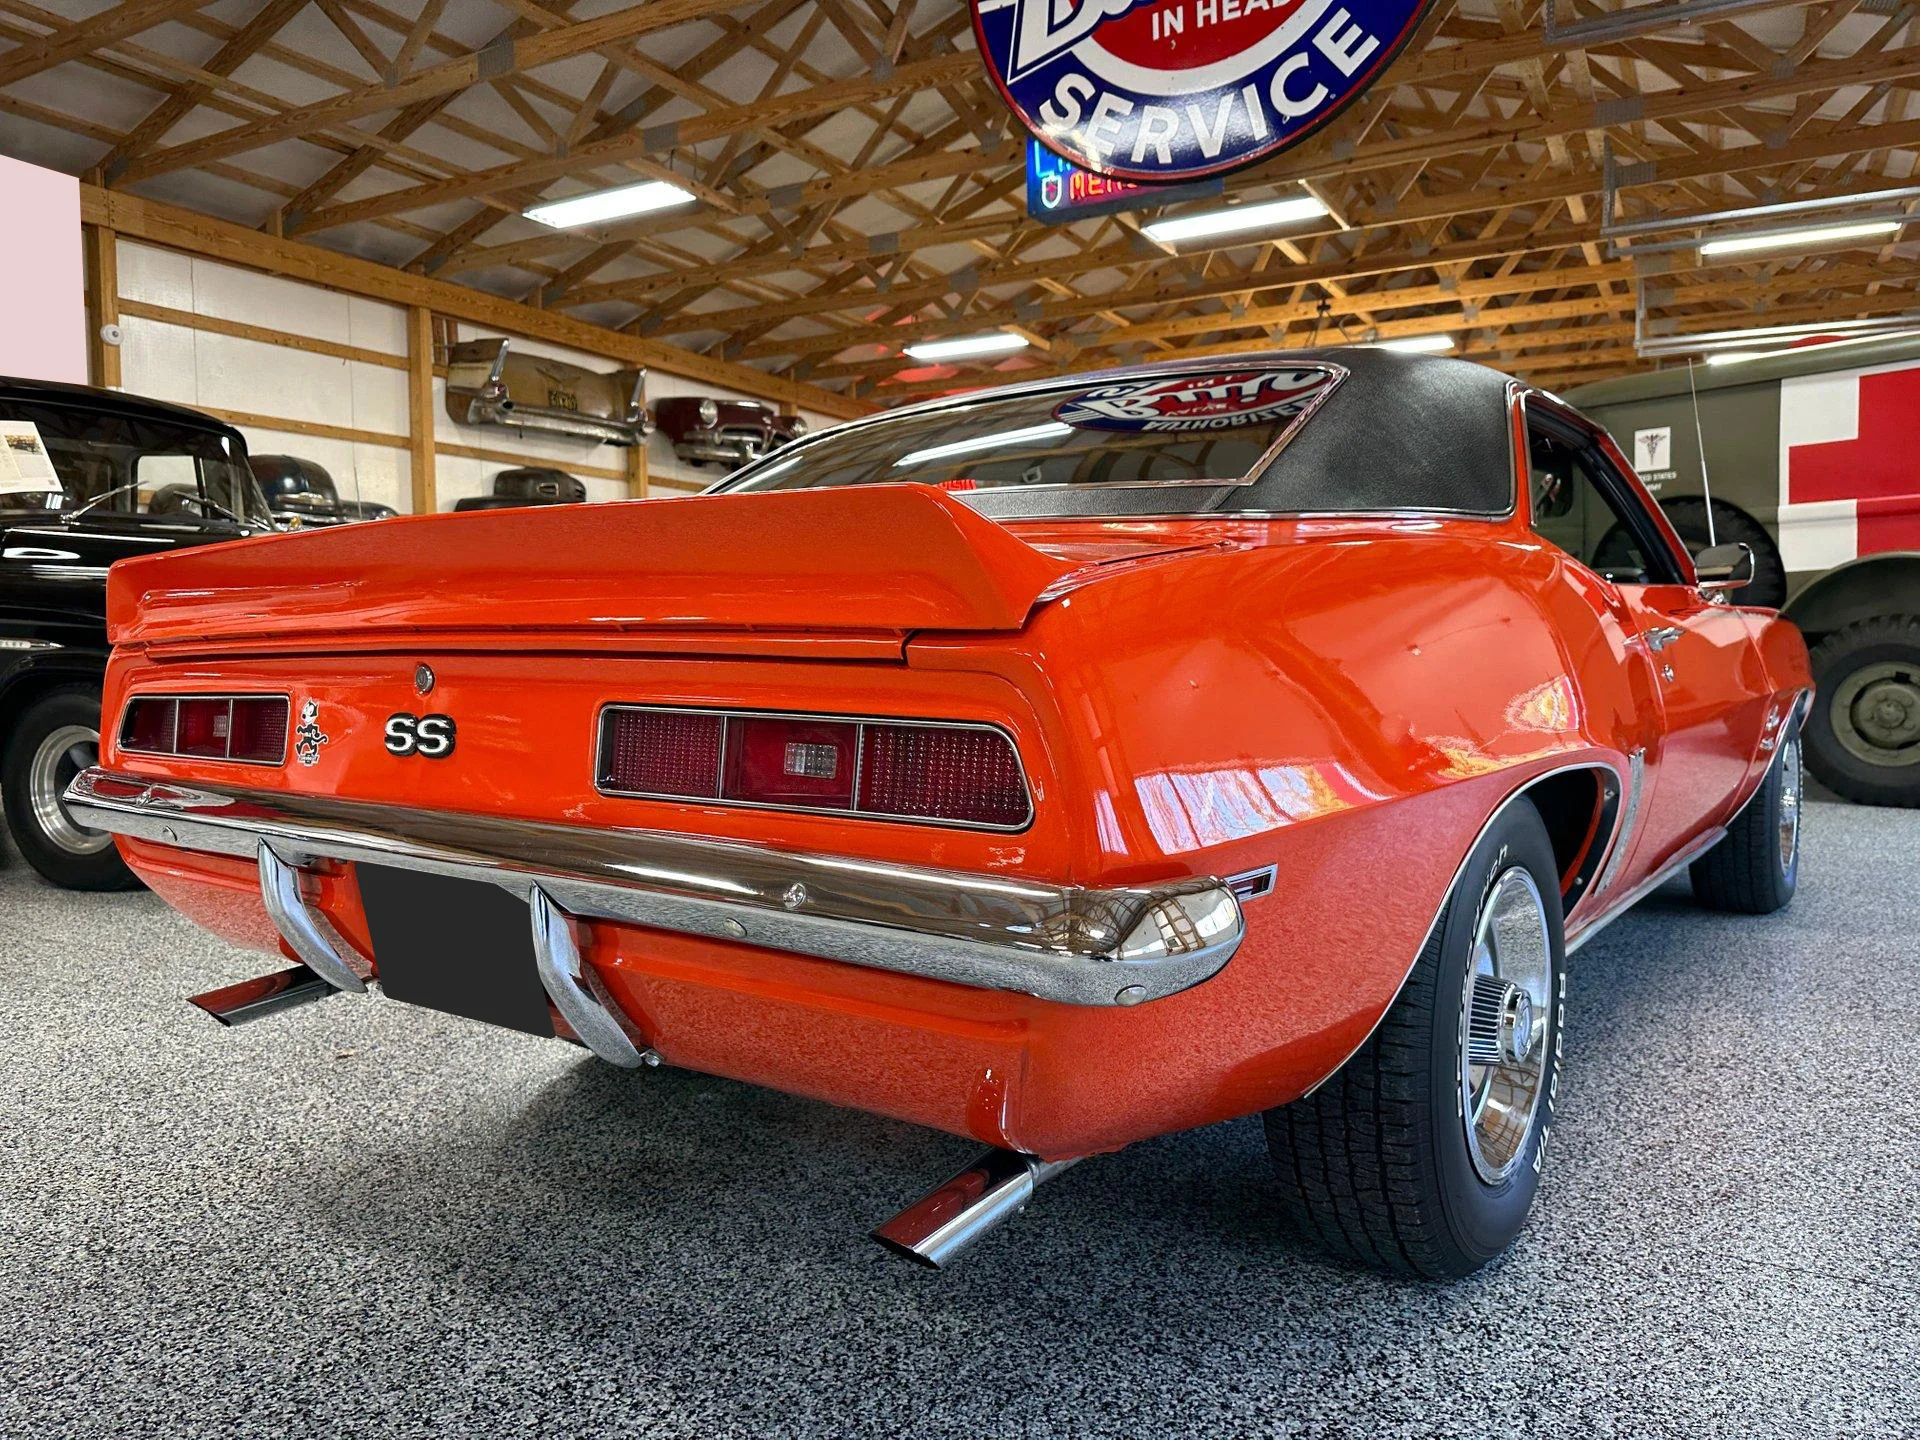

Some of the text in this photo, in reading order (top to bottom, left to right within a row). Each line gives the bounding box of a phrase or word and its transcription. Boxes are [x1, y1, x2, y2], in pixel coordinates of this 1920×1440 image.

[1152, 5, 1184, 41] IN
[1039, 8, 1381, 164] SERVICE
[384, 713, 456, 758] SS
[1532, 972, 1566, 1174] Radial T/A
